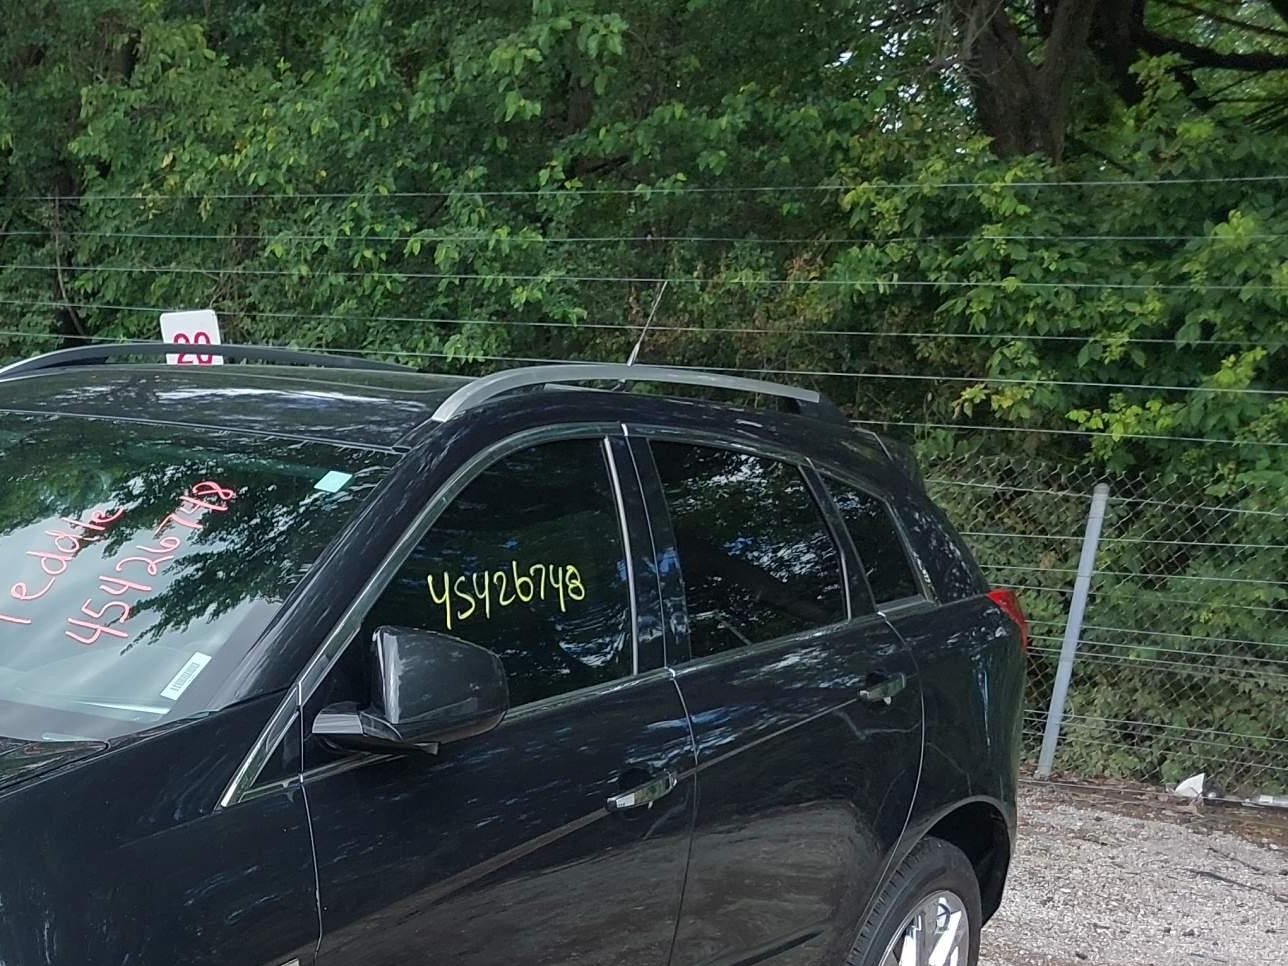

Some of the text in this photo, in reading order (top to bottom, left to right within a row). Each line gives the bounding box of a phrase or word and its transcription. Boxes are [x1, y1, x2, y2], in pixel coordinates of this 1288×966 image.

[173, 331, 214, 366] 20
[64, 481, 236, 645] 45426748
[427, 560, 585, 630] 45426748
